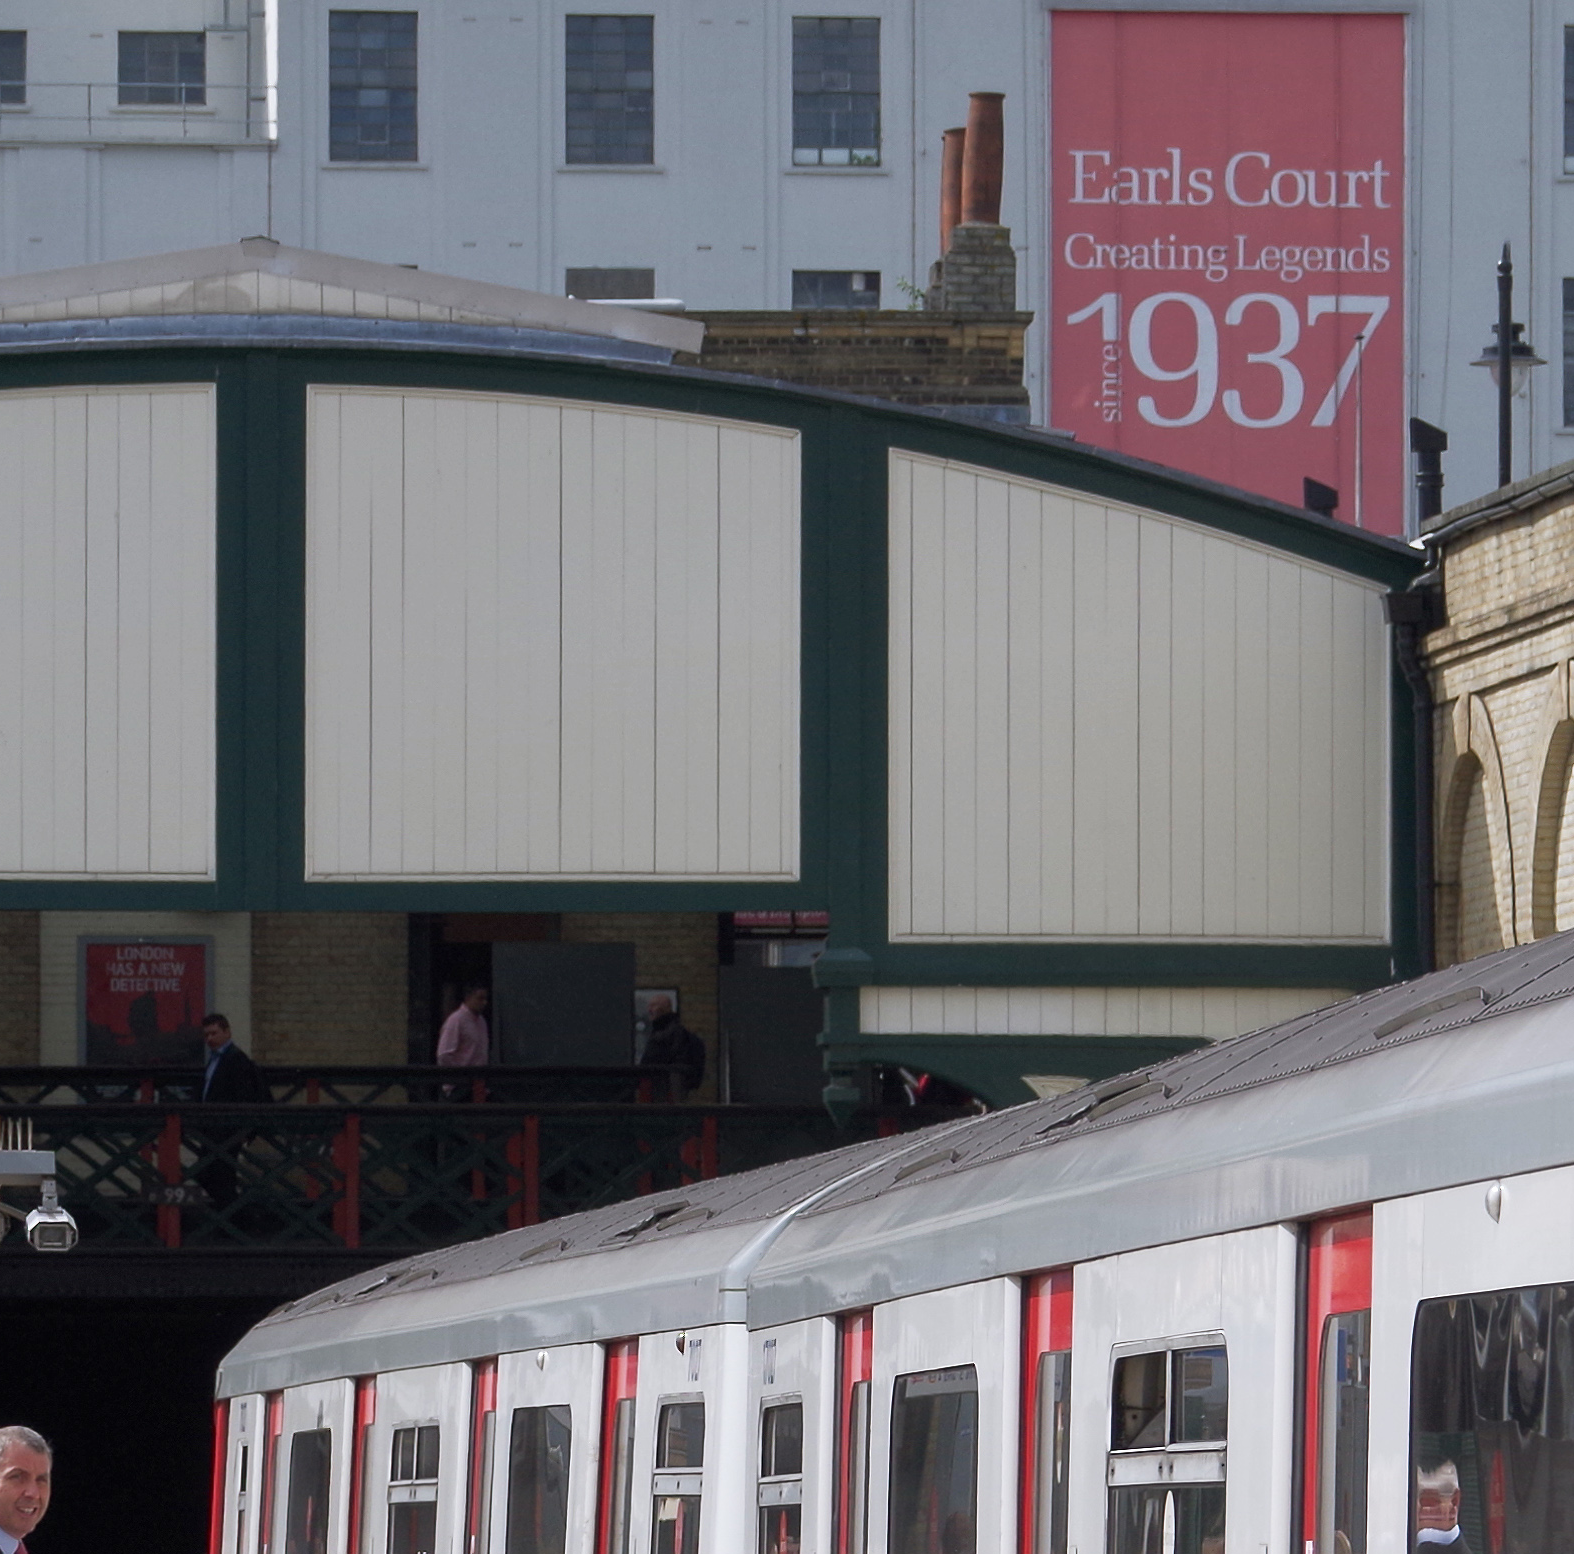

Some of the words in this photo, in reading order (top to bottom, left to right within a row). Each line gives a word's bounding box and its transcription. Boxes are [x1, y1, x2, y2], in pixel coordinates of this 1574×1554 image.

[1068, 147, 1214, 206] Earls
[1225, 151, 1392, 209] Court
[1064, 233, 1229, 283] Creating
[1234, 234, 1392, 284] Legends
[1067, 292, 1391, 428] 1937
[1094, 344, 1122, 423] since
[106, 962, 134, 976] HAS
[137, 962, 149, 976] A
[151, 961, 186, 976] NEW
[116, 946, 175, 961] LONDON
[110, 978, 181, 992] DETECTIVE
[165, 1187, 185, 1203] 99
